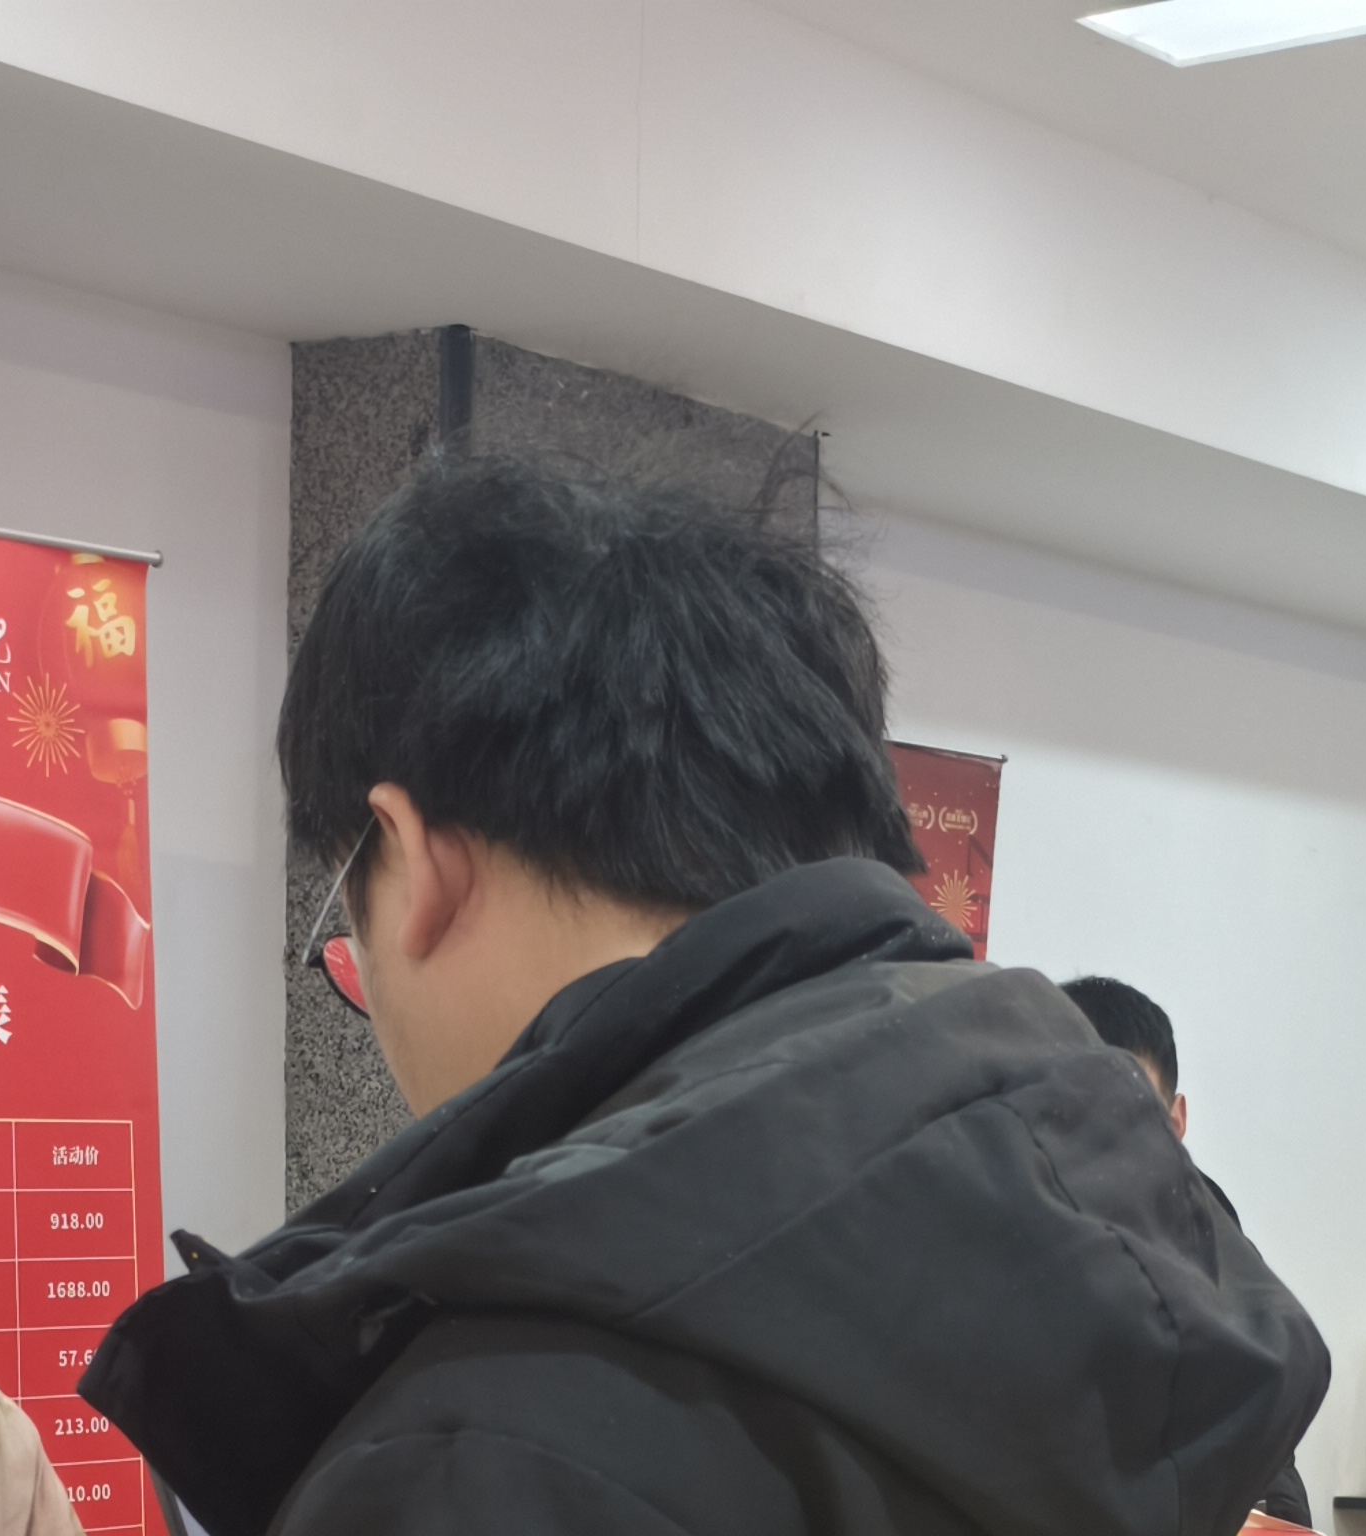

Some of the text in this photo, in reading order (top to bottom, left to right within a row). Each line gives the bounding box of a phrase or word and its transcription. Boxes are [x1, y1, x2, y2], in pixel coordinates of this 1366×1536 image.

[65, 578, 137, 668] 福
[52, 1145, 100, 1166] 活动价
[50, 1213, 104, 1230] 918.00
[47, 1281, 111, 1299] 1688.00
[58, 1349, 98, 1368] 57.6
[55, 1416, 109, 1436] 213.00
